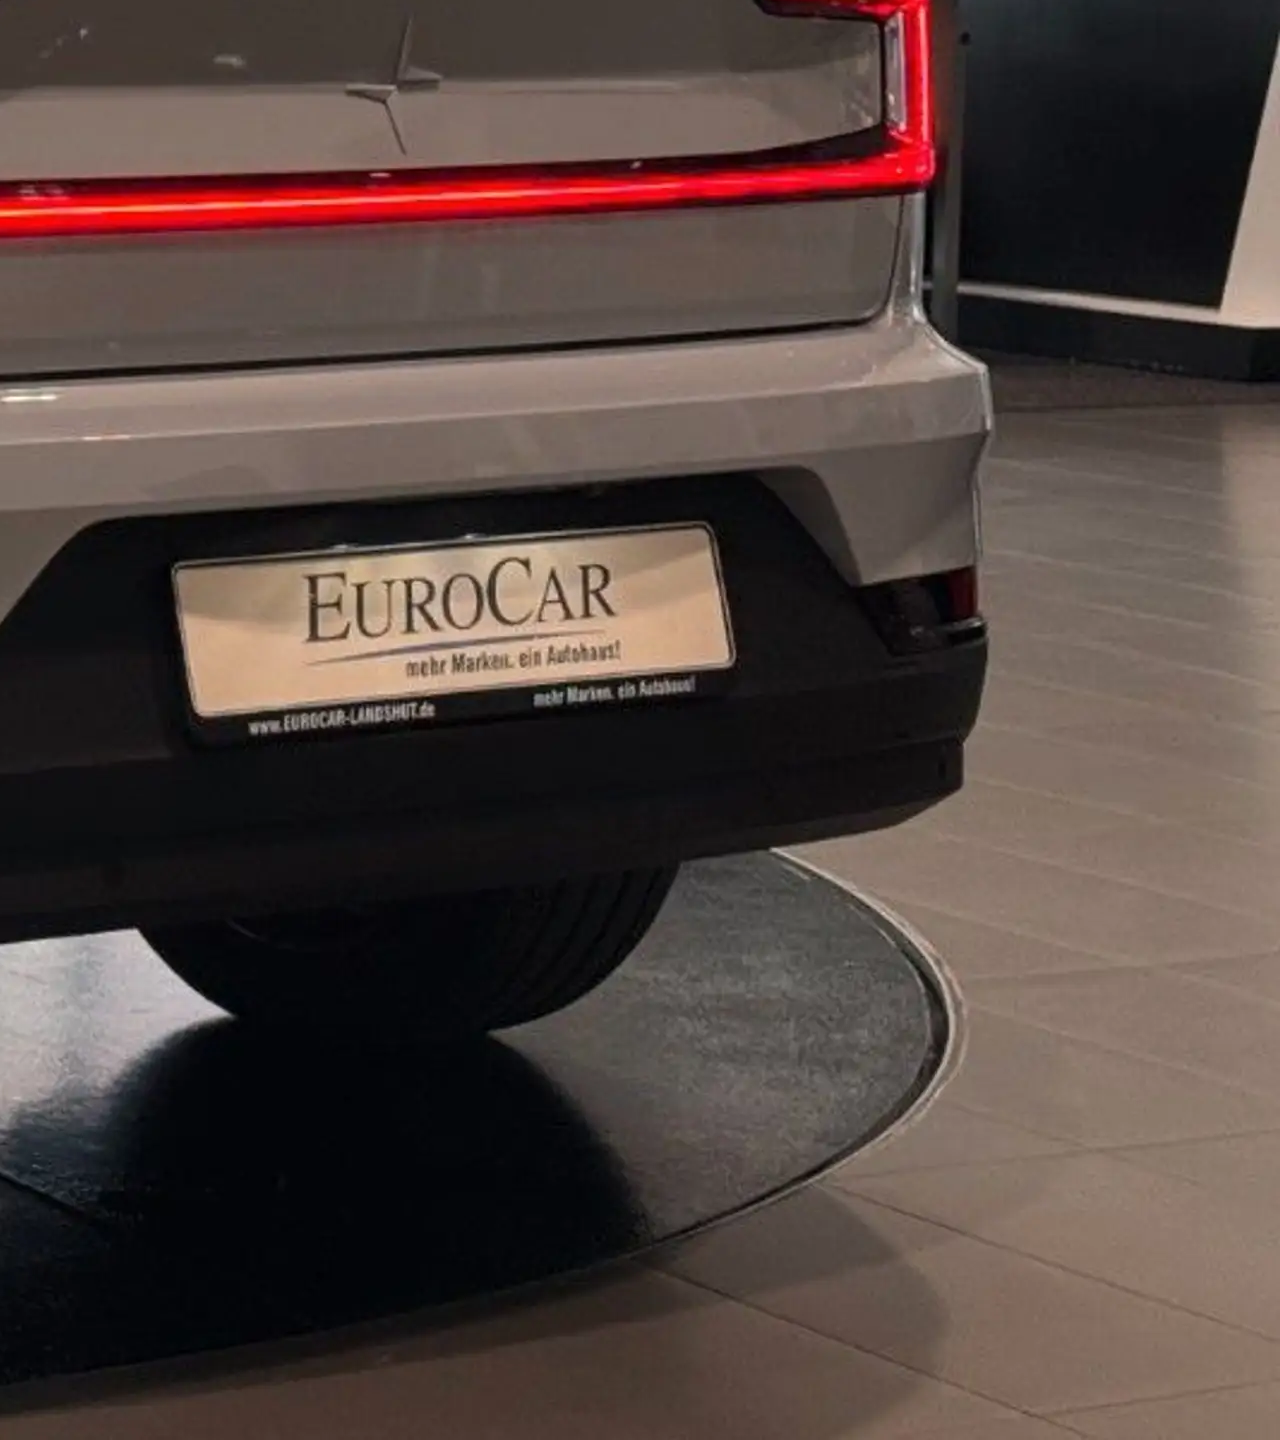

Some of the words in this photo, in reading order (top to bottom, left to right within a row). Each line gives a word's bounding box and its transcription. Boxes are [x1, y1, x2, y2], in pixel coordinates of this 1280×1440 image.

[405, 656, 447, 678] mehr
[519, 648, 541, 669] ein
[546, 640, 622, 665] Autohaus!
[533, 689, 565, 708] mehr
[617, 681, 637, 700] ein
[639, 675, 696, 696] Autohaus!
[248, 702, 435, 735] www.EUROCAR-LANDSHUT.de
